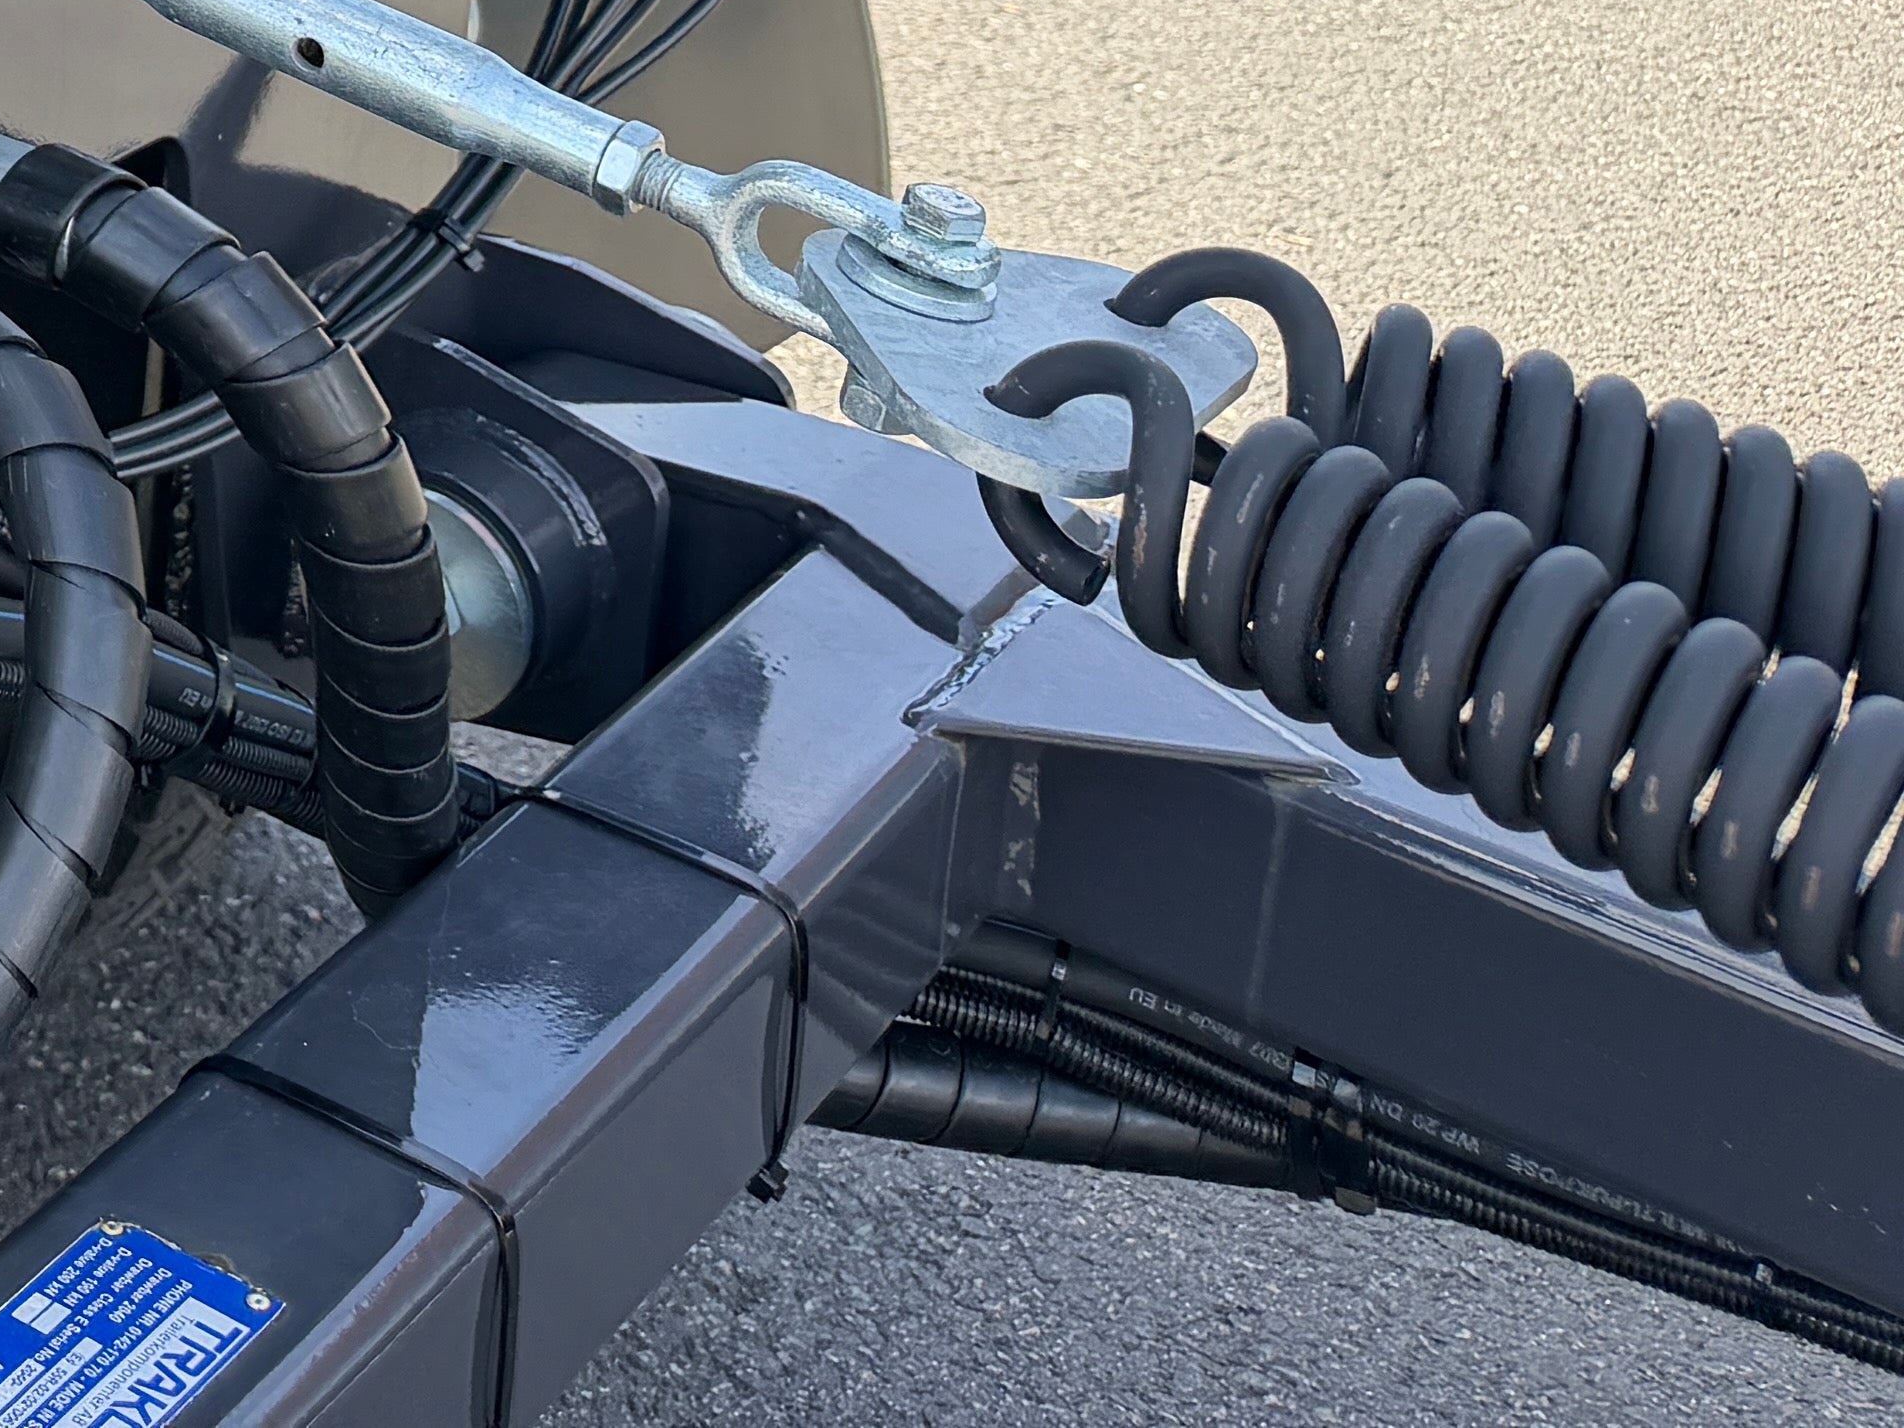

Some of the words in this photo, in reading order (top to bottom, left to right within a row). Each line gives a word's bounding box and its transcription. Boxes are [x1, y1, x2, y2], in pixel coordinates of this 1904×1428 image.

[1124, 983, 1161, 1012] EU
[72, 1236, 112, 1269] D-value
[91, 1246, 131, 1278] D-value
[108, 1257, 151, 1292] Drawbar
[128, 1267, 172, 1303] Drawbar
[42, 1281, 64, 1297] kN
[61, 1291, 83, 1306] kN
[151, 1278, 193, 1313] PHONE
[81, 1292, 114, 1318] Class
[106, 1300, 135, 1323] 2040
[134, 1309, 159, 1329] NR.
[46, 1324, 80, 1350] Serial
[95, 1326, 143, 1366] 0142-170
[83, 1363, 103, 1378] 70
[86, 1313, 195, 1409] Trailerkomponenter
[47, 1379, 85, 1411] MADE
[34, 1408, 55, 1424] IN
[69, 1406, 93, 1428] AB
